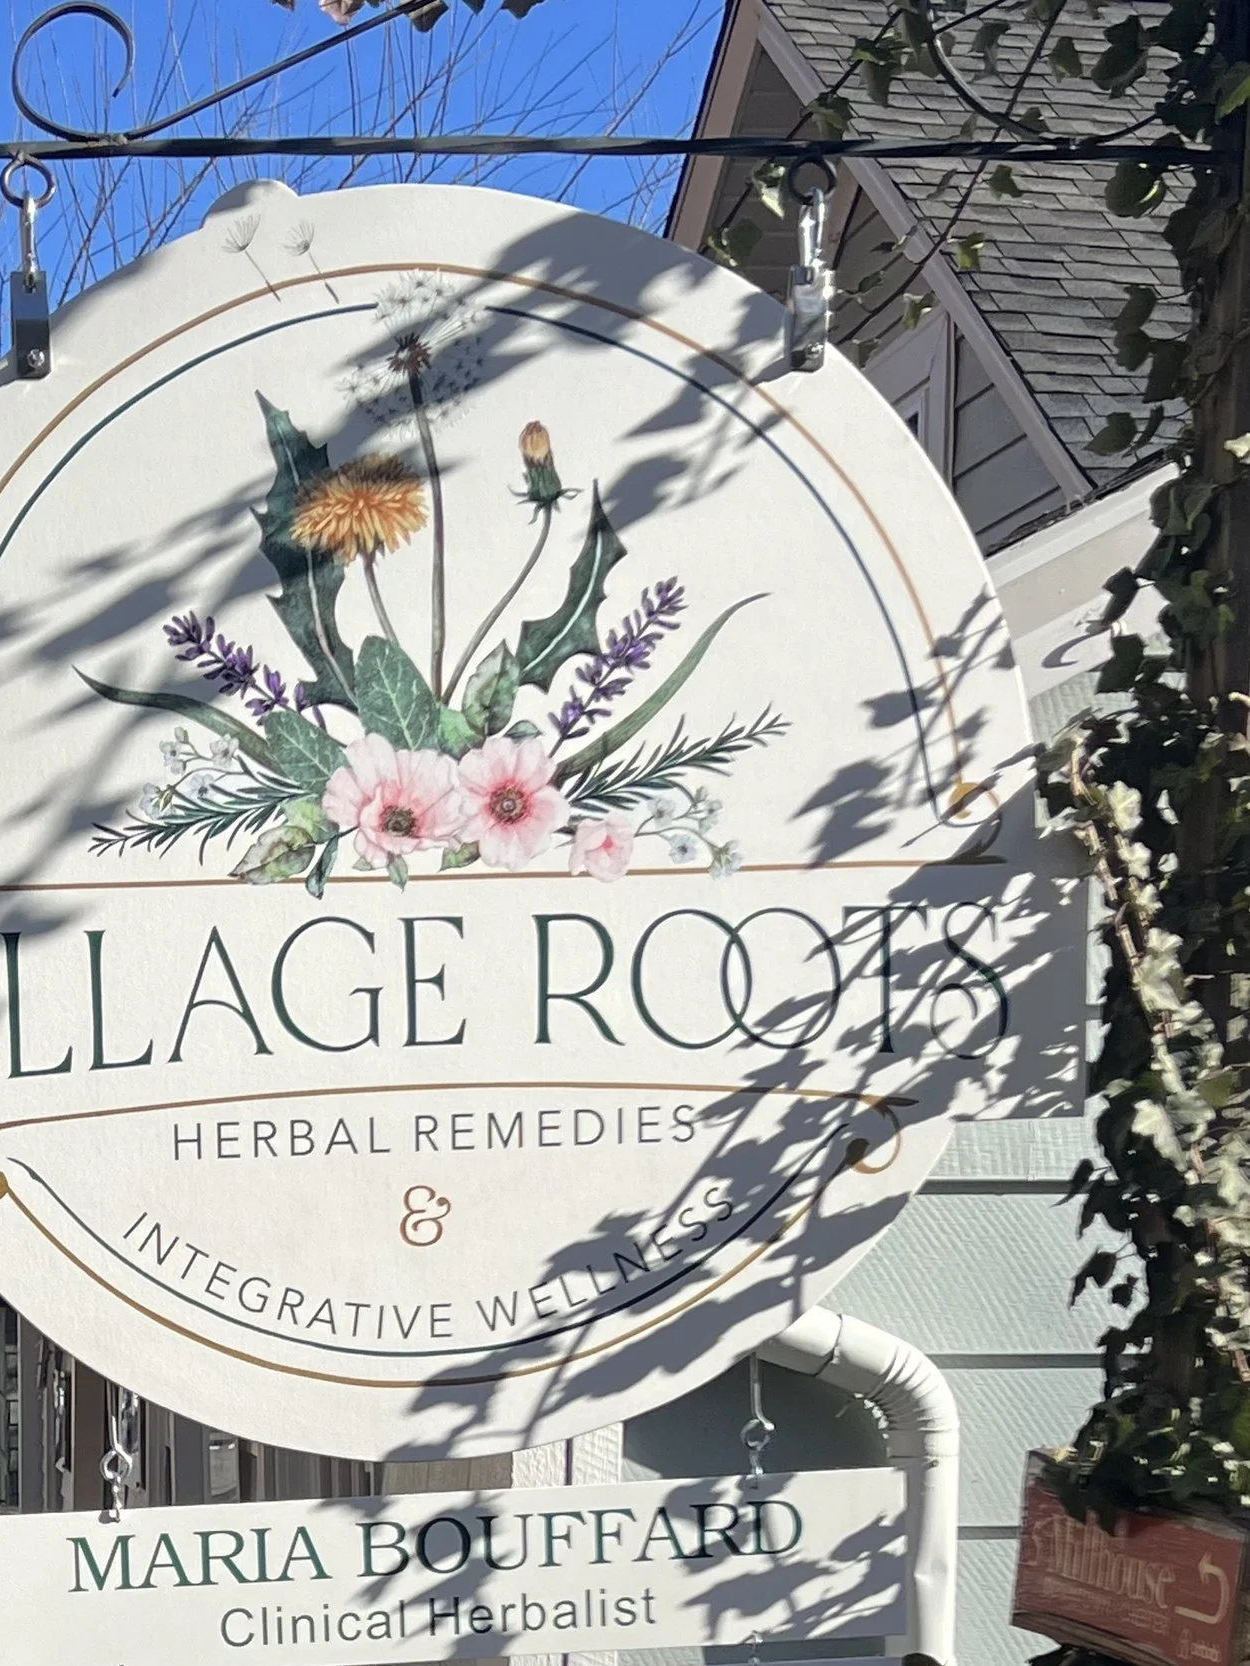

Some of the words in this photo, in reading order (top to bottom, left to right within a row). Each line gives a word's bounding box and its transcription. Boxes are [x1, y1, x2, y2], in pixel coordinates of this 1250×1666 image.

[532, 901, 1011, 1060] ROOTS
[173, 1116, 391, 1161] HERBAL
[414, 1104, 696, 1152] REMEDIES
[400, 1185, 452, 1247] &
[122, 1211, 453, 1339] INTEGRATIVE
[475, 1186, 735, 1332] WELLNESS
[65, 1525, 333, 1593] MARIA
[354, 1499, 803, 1578] BOUFFARD
[220, 1600, 406, 1648] Clinical
[428, 1587, 657, 1637] Herbalist
